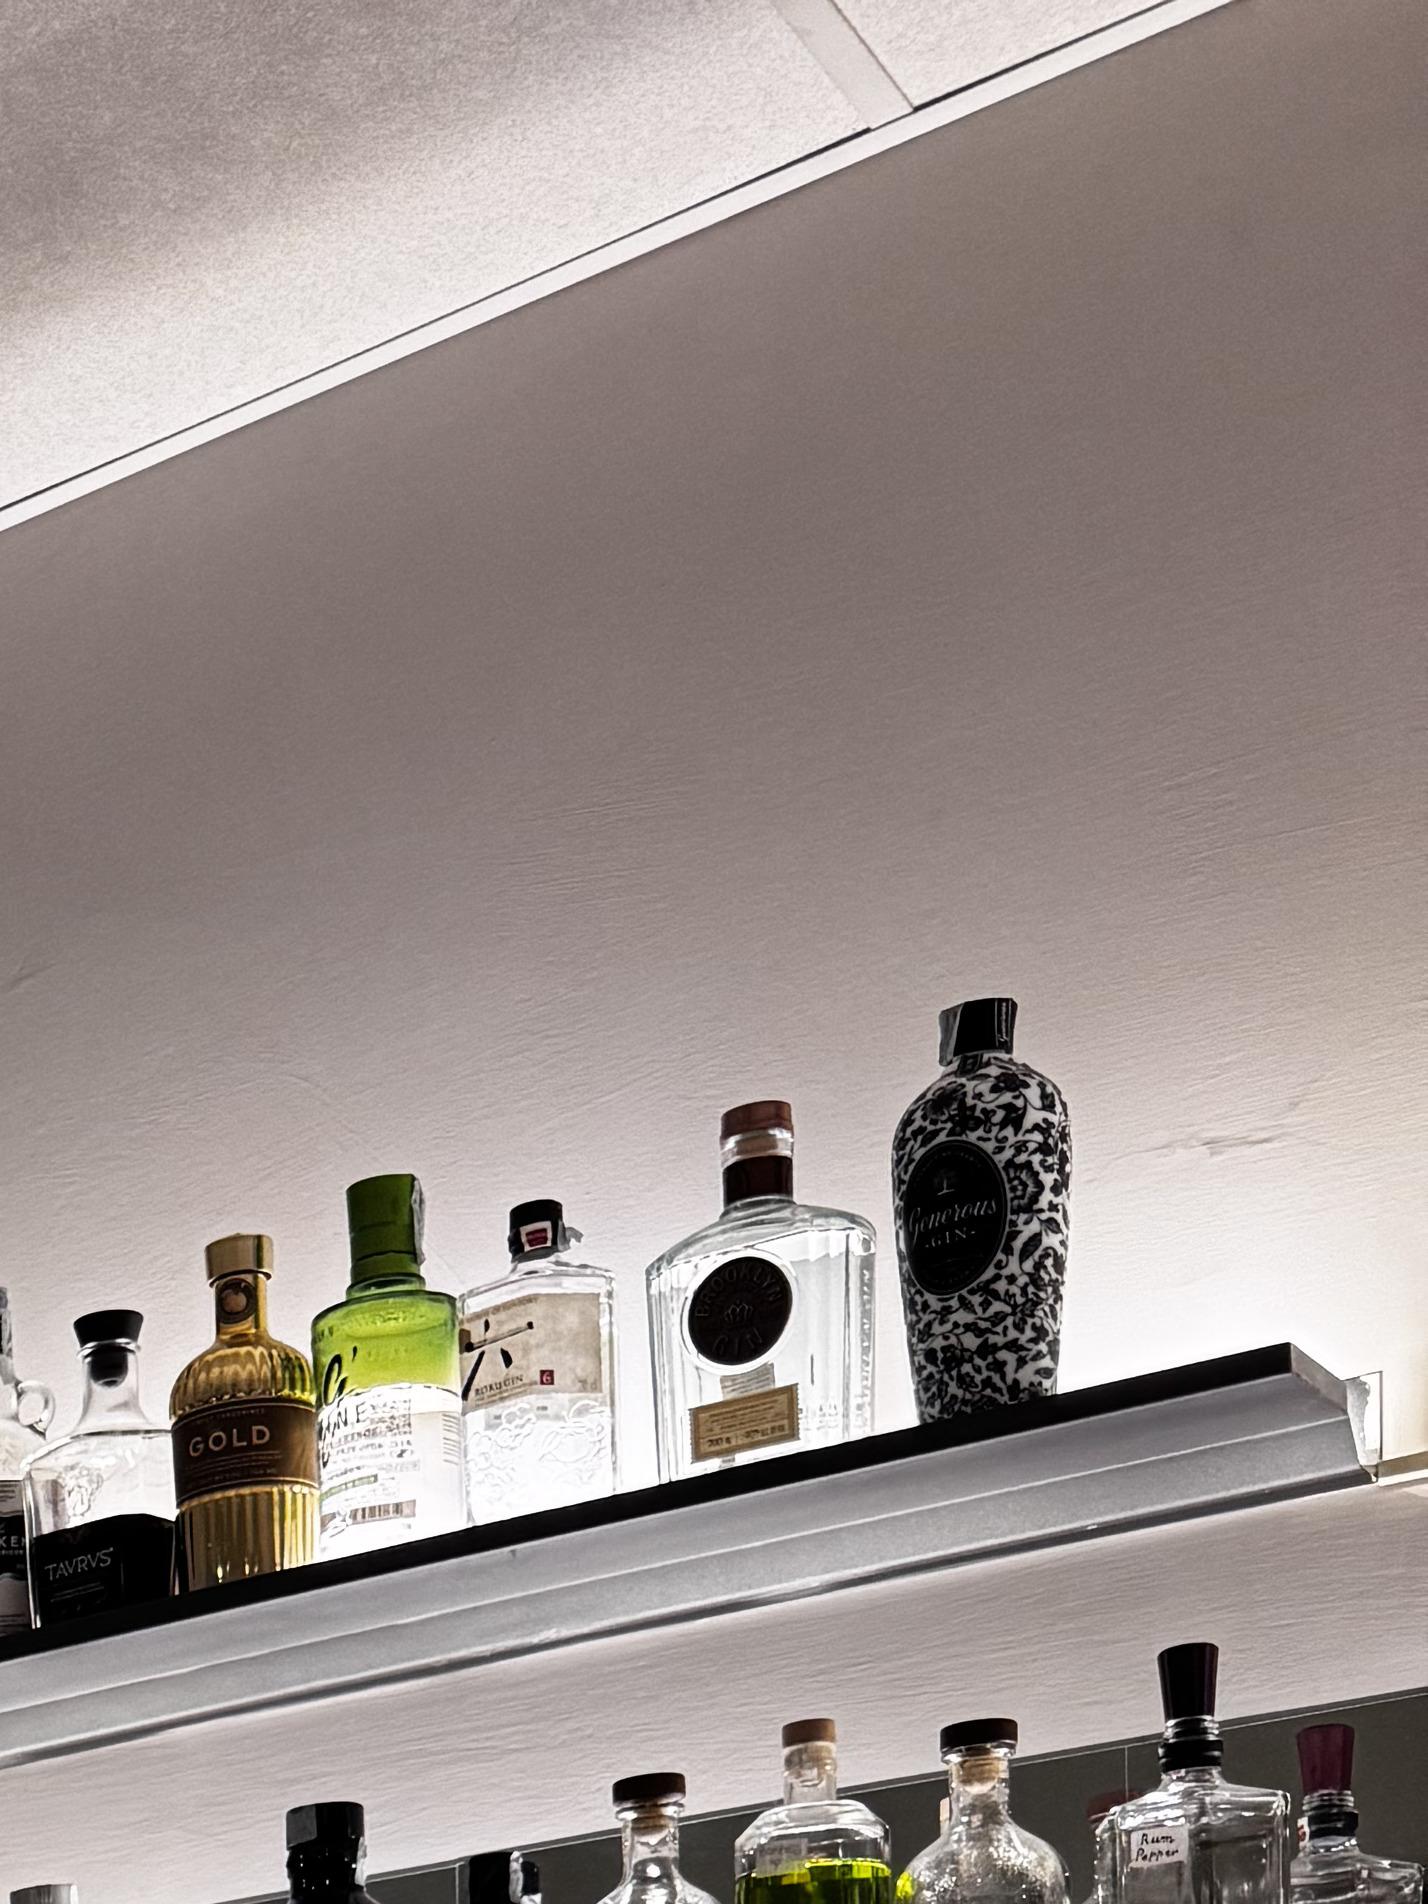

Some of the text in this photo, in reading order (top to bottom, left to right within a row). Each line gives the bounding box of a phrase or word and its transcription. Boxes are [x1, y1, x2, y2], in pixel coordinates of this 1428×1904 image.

[909, 1200, 996, 1247] Generous
[696, 1265, 783, 1317] BROOKLYN
[713, 1327, 762, 1356] GIN
[189, 1425, 270, 1457] GOLD
[44, 1548, 113, 1581] TAVRVS
[1141, 1832, 1175, 1845] Rum
